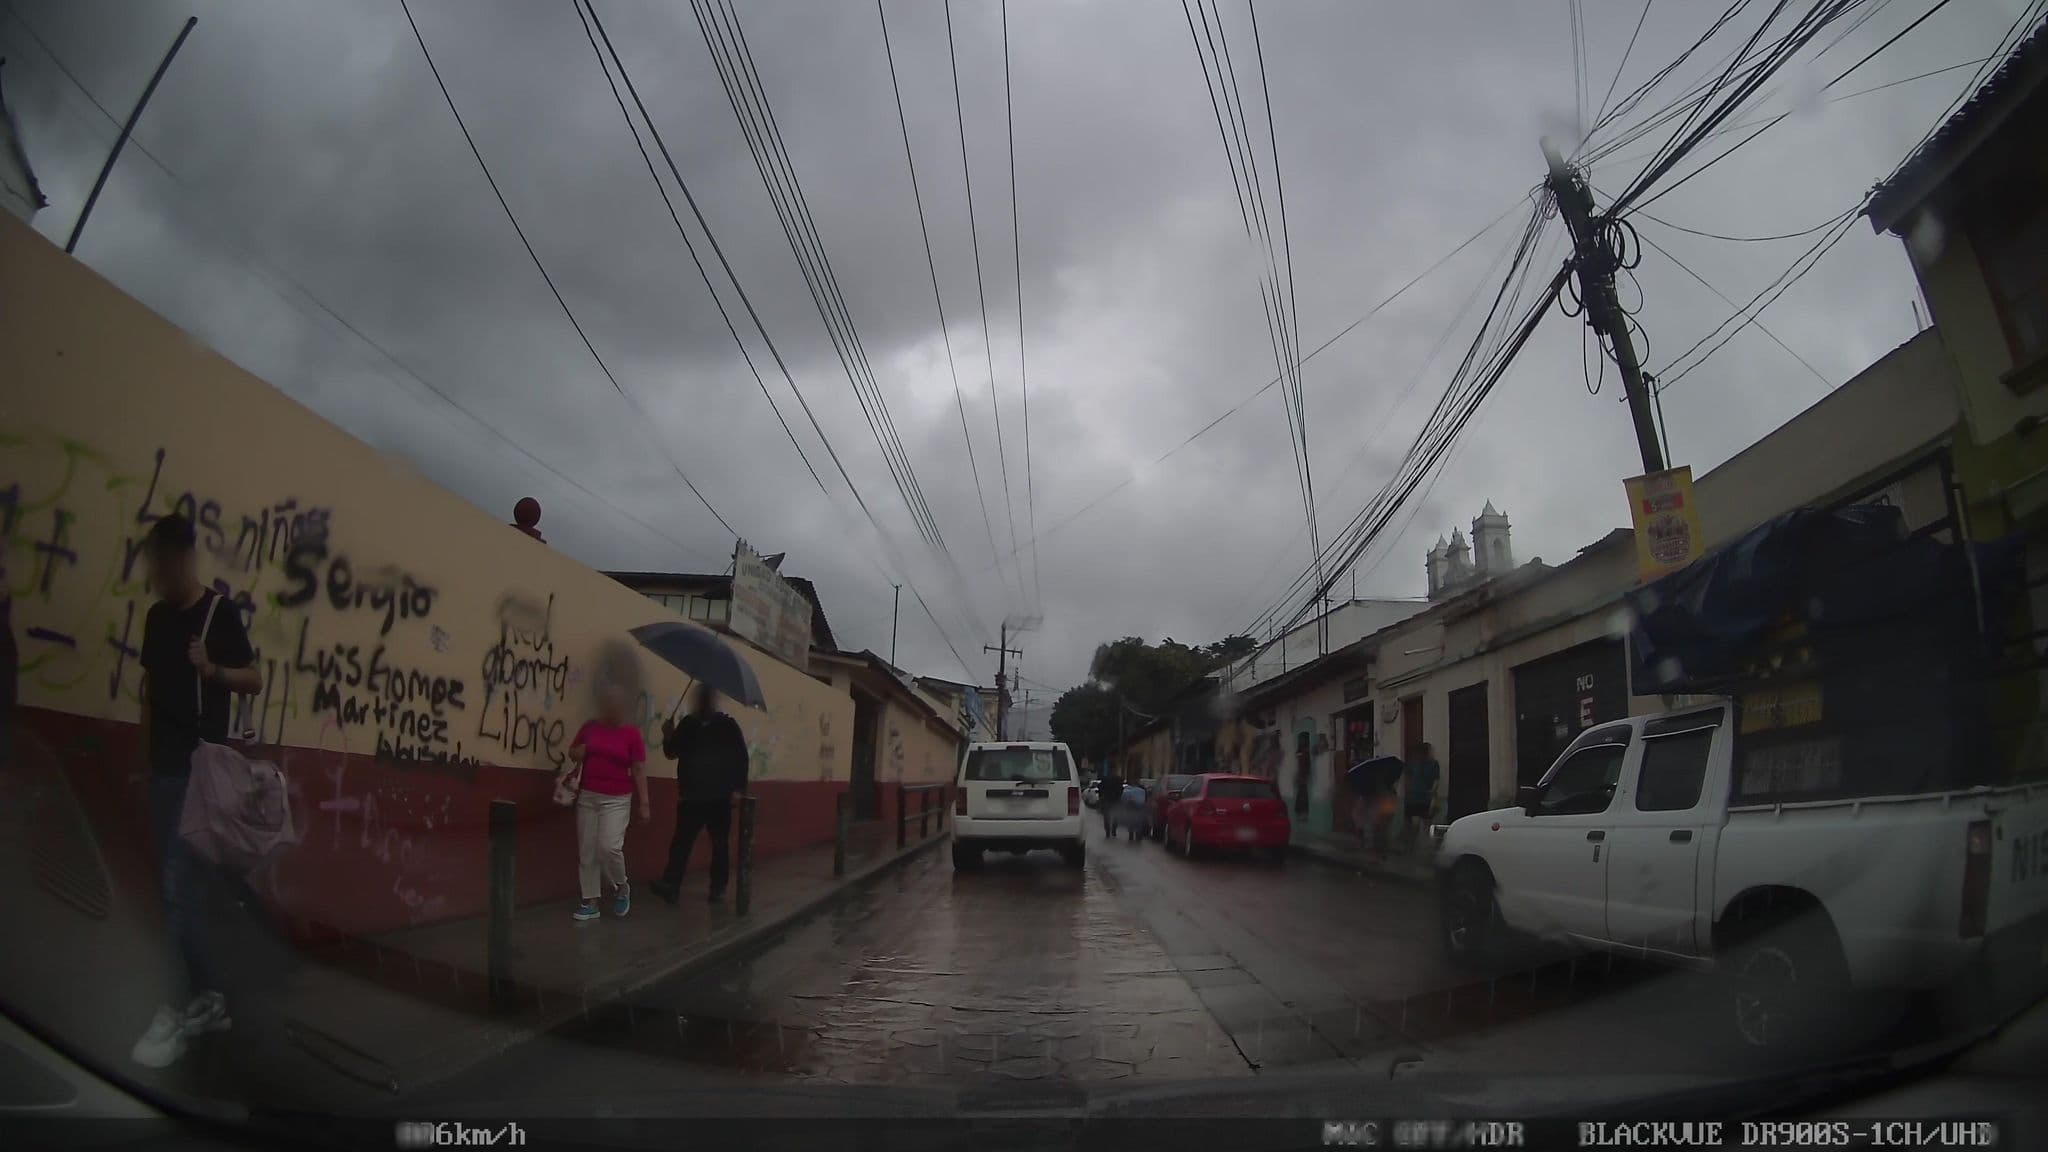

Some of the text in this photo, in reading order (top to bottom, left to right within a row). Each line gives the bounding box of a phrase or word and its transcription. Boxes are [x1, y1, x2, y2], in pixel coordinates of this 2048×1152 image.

[277, 540, 438, 638] Sergio
[296, 615, 362, 687] Luis
[367, 643, 466, 717] Gomez
[1576, 673, 1594, 692] NO
[313, 680, 448, 745] Martinez
[479, 689, 566, 770] Libre
